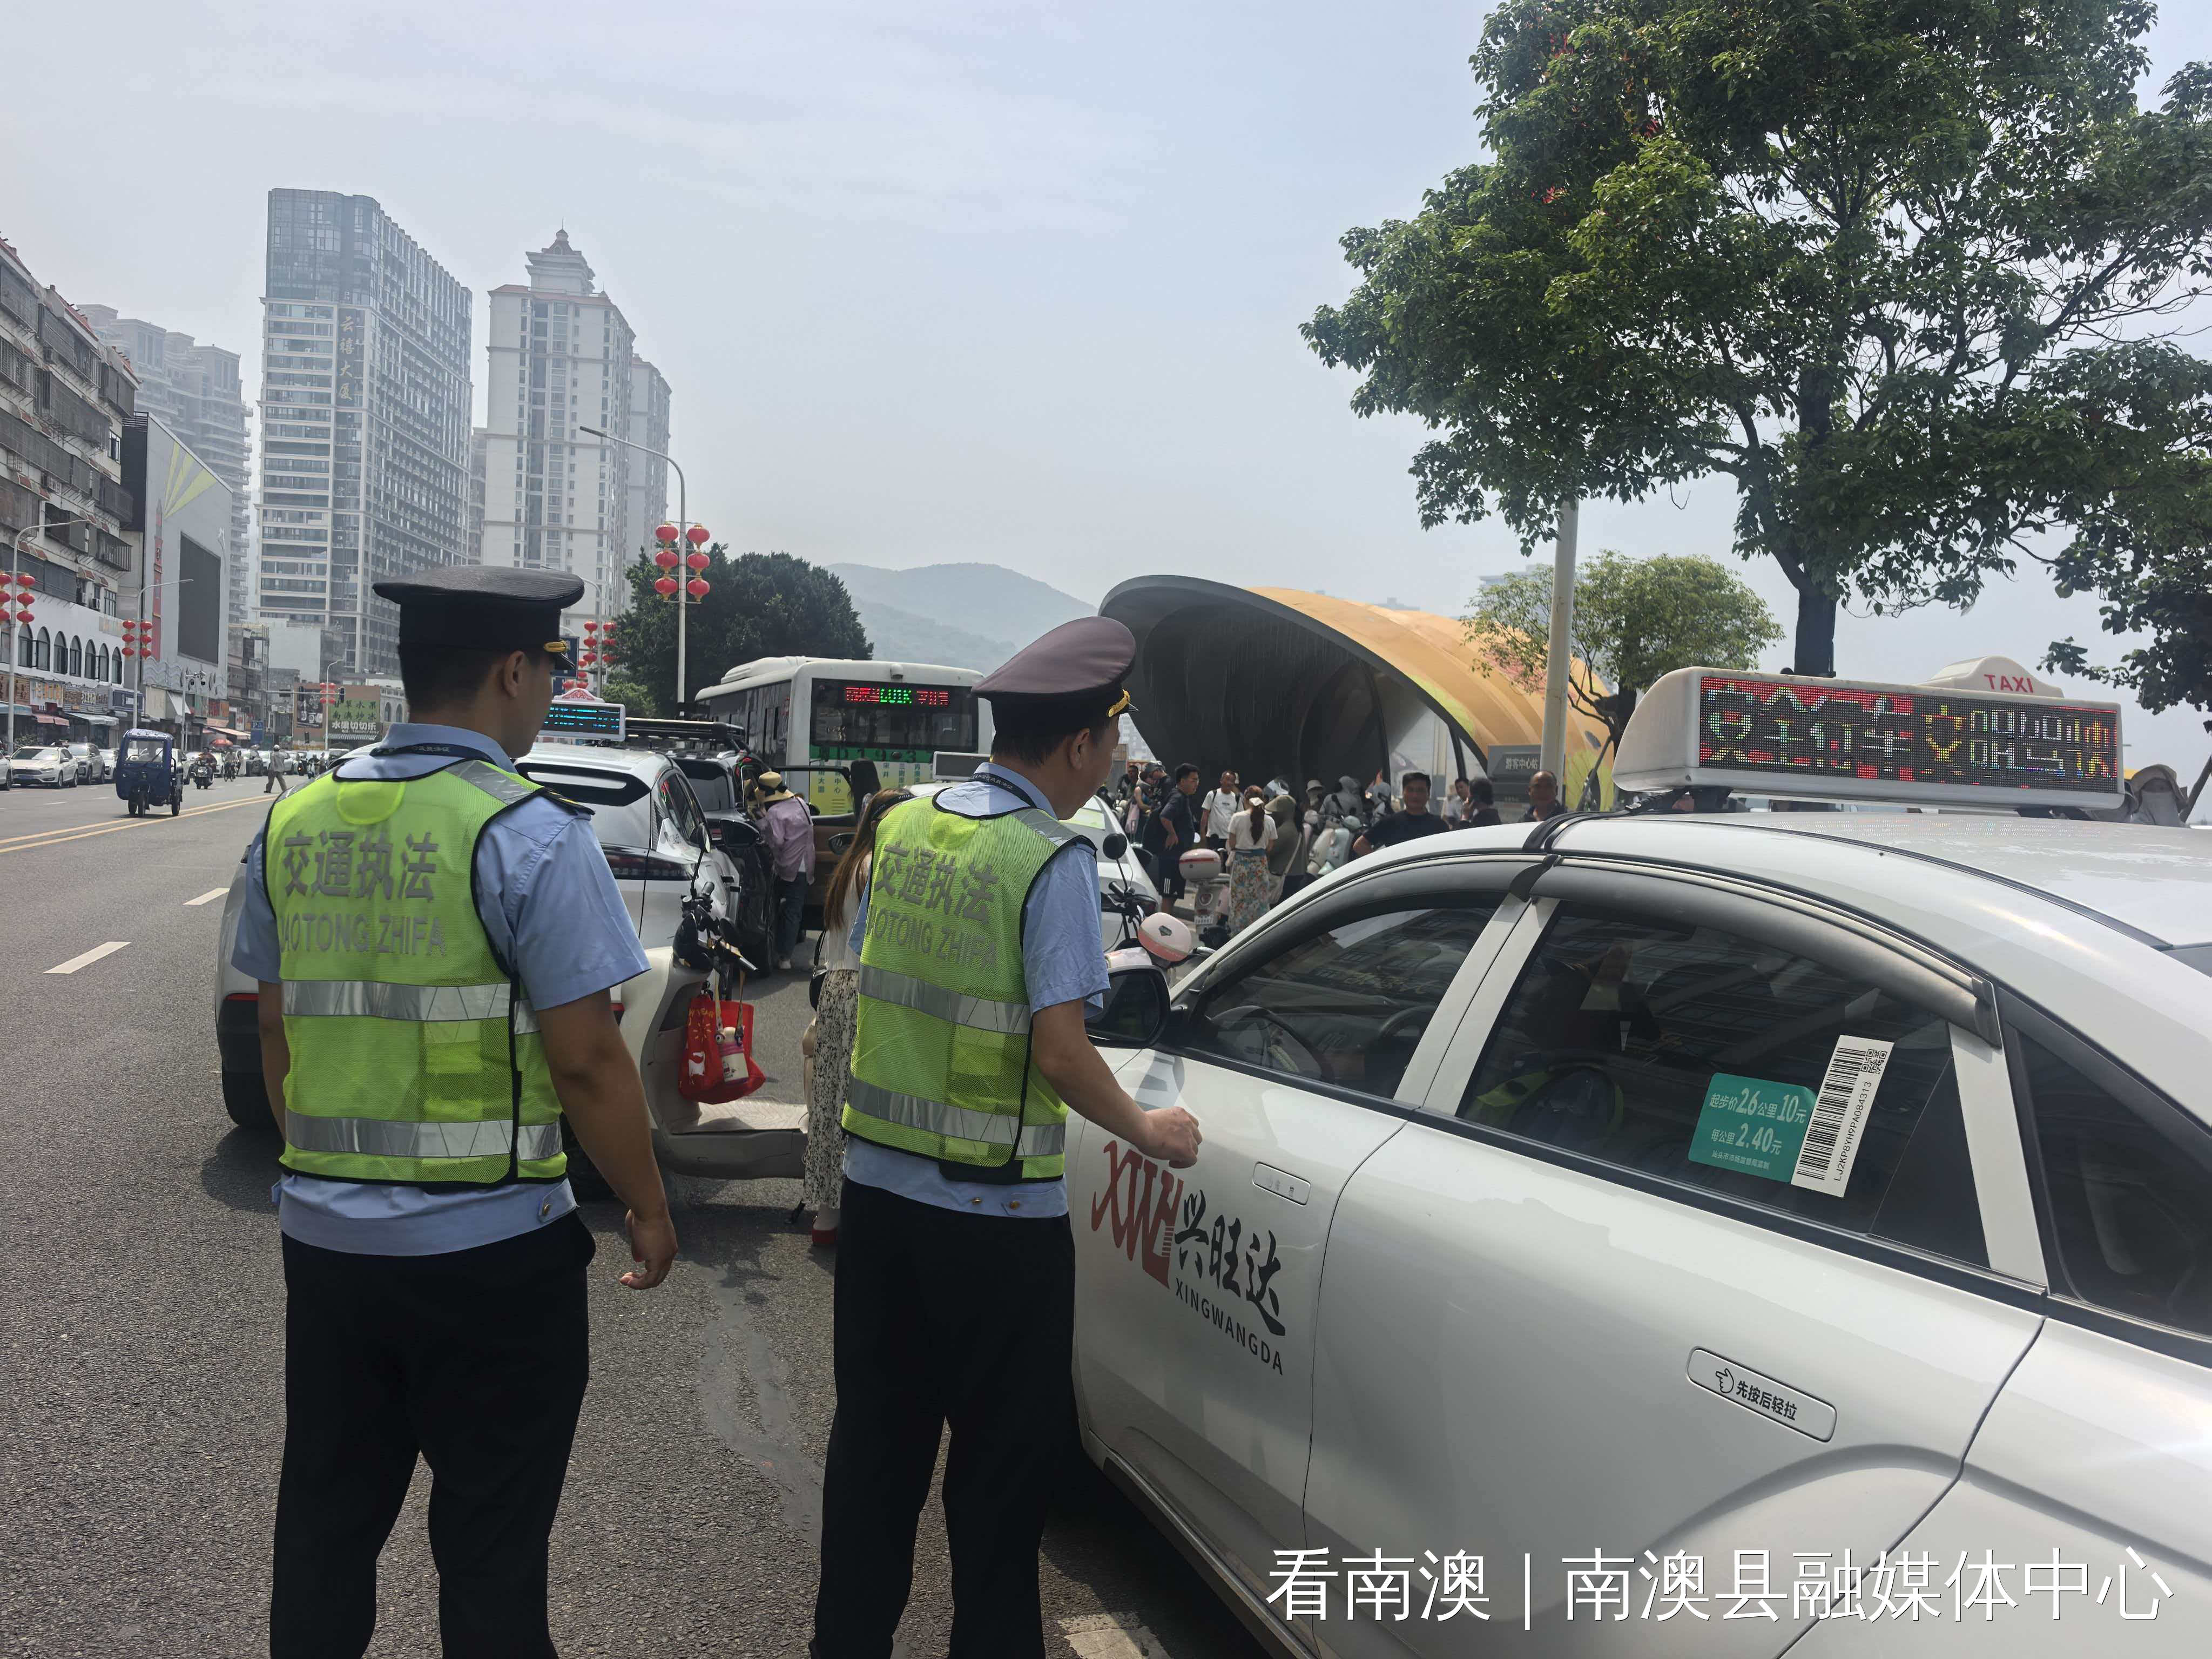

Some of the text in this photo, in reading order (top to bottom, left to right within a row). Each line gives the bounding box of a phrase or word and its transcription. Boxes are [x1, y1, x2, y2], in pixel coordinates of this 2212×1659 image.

[1984, 673, 2034, 693] TAXI
[283, 828, 439, 902] 交通执法
[874, 840, 999, 925] 交通执法
[376, 913, 447, 956] ZHIFA
[936, 926, 997, 970] ZHIFA
[1833, 1081, 1872, 1182] LJ2KP8YH9PA084313
[1174, 1189, 1286, 1337] 兴旺达
[1175, 1277, 1284, 1376] XINGWANGDA
[1736, 1380, 1798, 1421] 先按后轻拉
